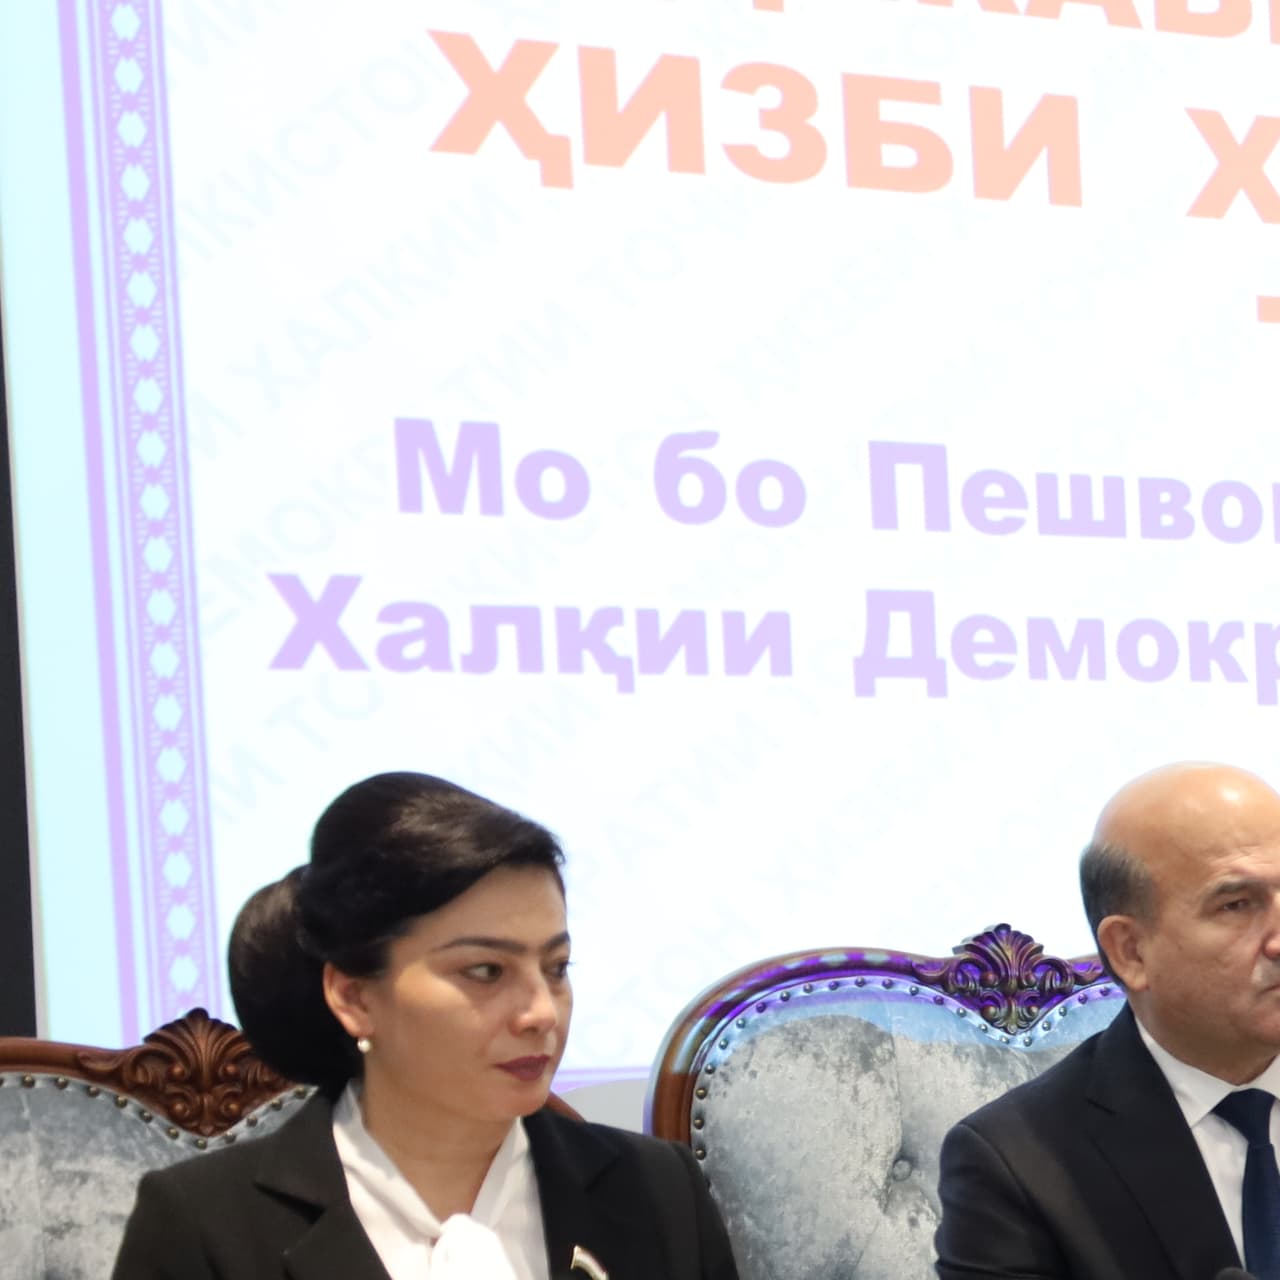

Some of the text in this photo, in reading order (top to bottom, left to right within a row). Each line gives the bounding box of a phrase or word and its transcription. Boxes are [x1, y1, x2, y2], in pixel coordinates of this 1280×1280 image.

[430, 31, 1082, 207] ҲИЗБИ
[394, 417, 591, 520] Мо
[654, 431, 807, 528] бо
[266, 572, 792, 694] Халқии
